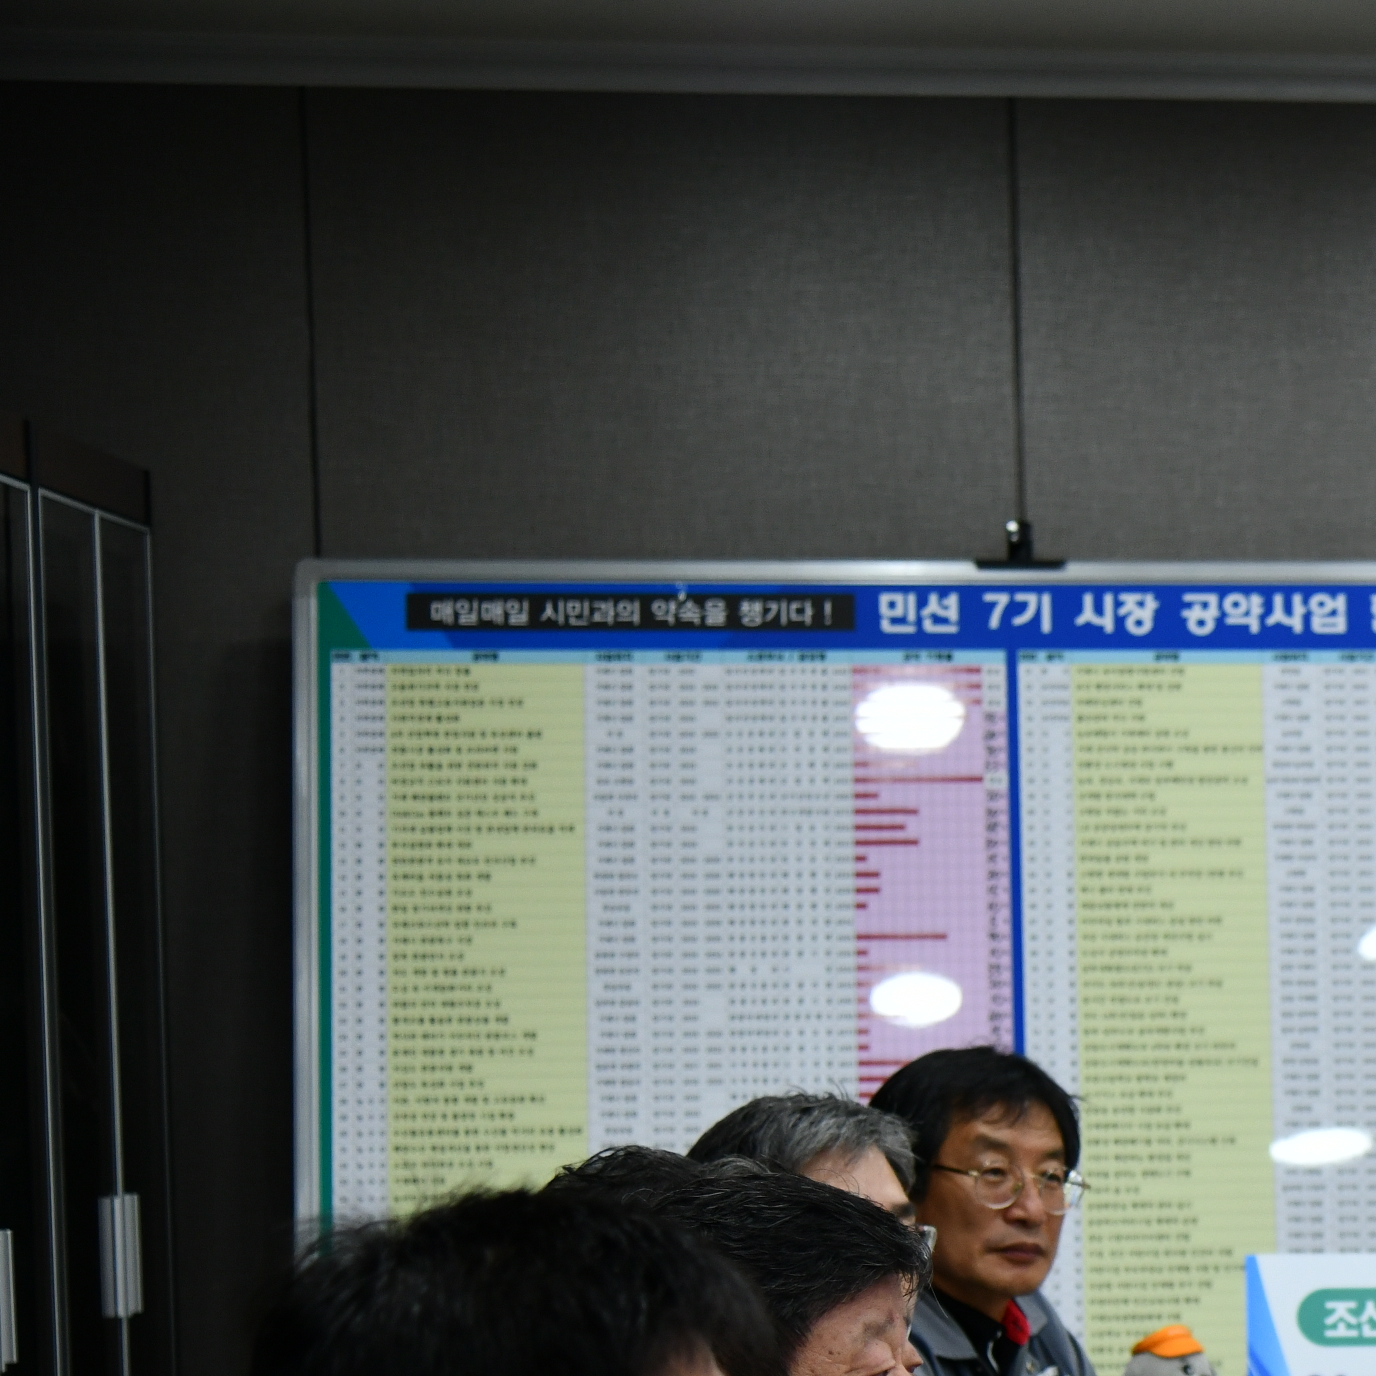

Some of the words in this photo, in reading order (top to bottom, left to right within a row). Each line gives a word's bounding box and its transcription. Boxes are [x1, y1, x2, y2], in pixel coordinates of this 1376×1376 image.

[429, 598, 530, 627] 매일매일
[539, 598, 641, 628] 시민과의
[651, 598, 728, 628] 약속을
[877, 592, 960, 635] 민선
[983, 592, 1053, 635] 7기
[1075, 592, 1159, 635] 시장
[1181, 592, 1348, 635] 공약사업
